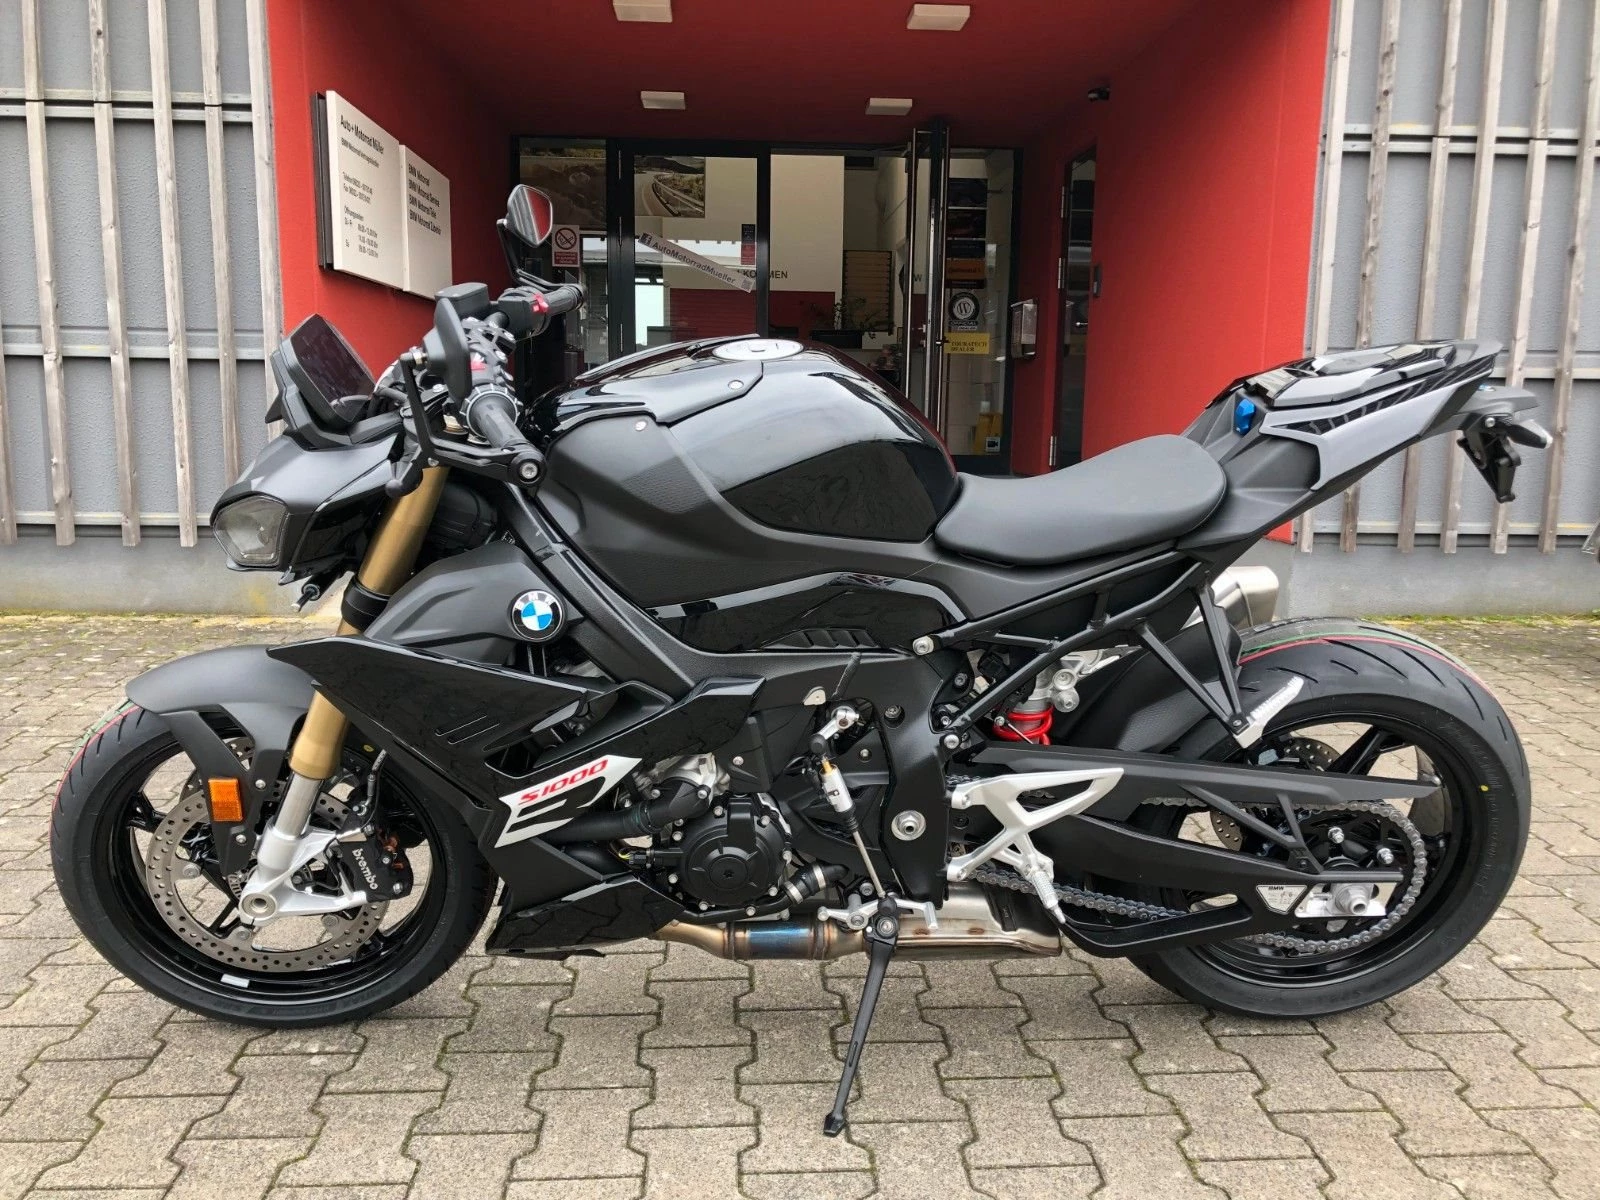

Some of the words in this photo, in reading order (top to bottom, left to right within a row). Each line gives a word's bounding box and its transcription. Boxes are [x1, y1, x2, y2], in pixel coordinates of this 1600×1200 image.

[409, 163, 417, 177] BMW
[417, 170, 430, 186] Motorrad
[409, 179, 417, 192] BMW
[417, 185, 430, 201] Motorrad
[409, 194, 417, 207] BMW
[417, 200, 430, 215] Motorrad
[409, 209, 417, 222] BMW
[417, 214, 430, 229] Motorrad
[652, 242, 736, 284] AutoMotorradMueller
[513, 591, 557, 610] BMW
[518, 759, 608, 805] S1000
[352, 848, 379, 890] brembo
